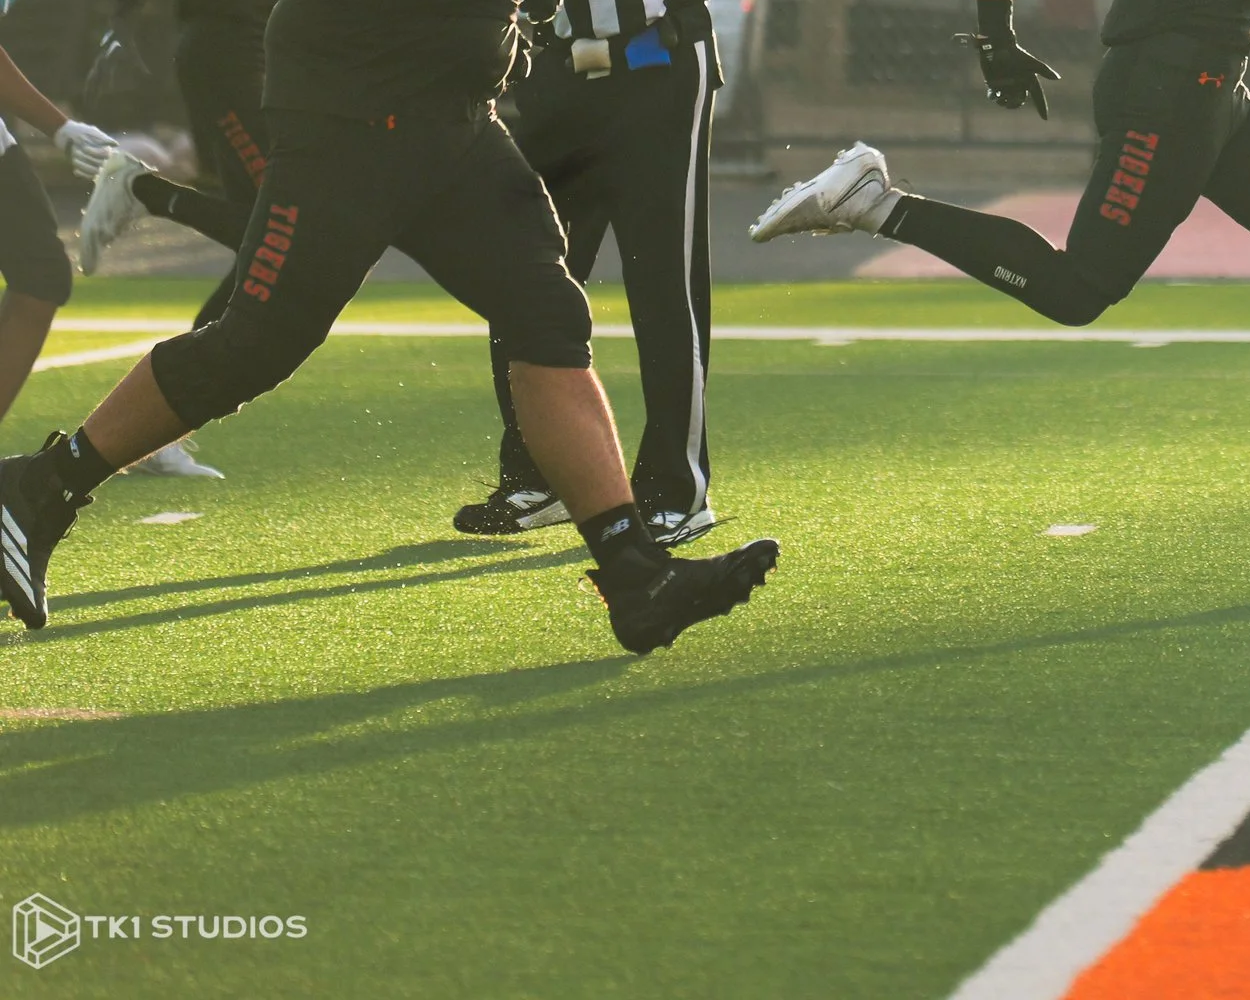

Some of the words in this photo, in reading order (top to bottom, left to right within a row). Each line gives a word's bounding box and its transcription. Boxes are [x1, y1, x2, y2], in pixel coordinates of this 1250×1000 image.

[1100, 130, 1160, 226] TIGERS
[243, 204, 299, 303] TIGERS
[994, 265, 1028, 289] NXTRND
